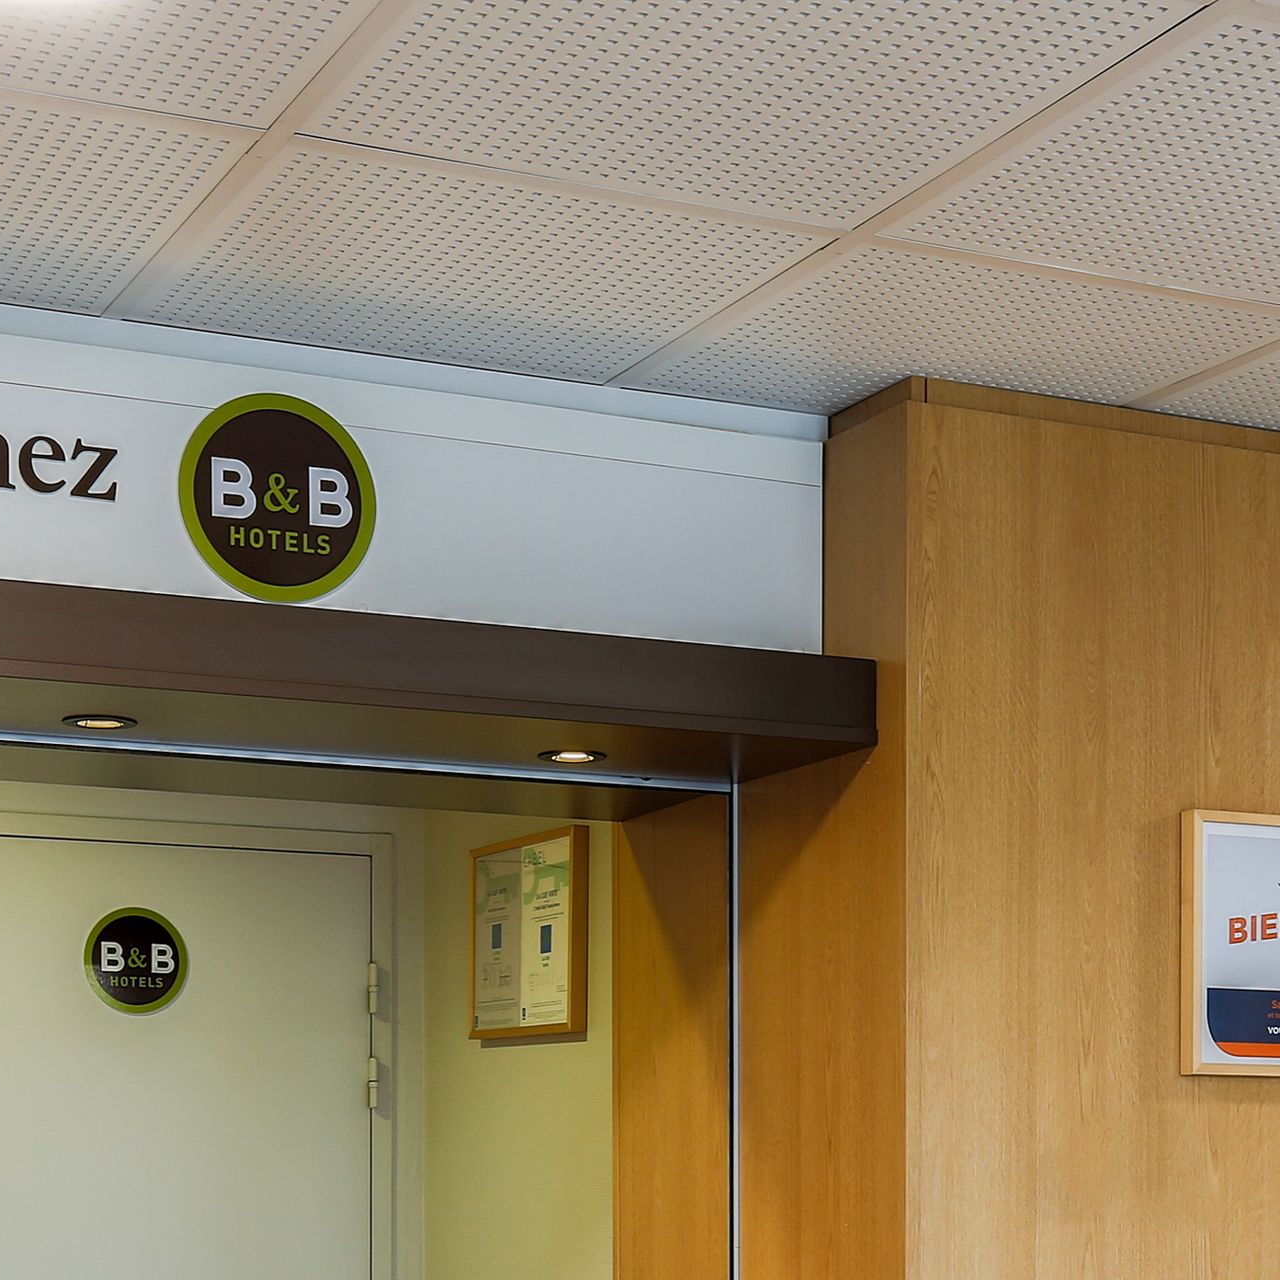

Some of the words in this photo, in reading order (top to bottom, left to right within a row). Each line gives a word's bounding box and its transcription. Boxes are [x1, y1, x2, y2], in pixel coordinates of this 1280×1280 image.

[230, 525, 332, 556] HOTELS
[100, 941, 175, 974] B&B
[110, 975, 164, 988] HOTELS
